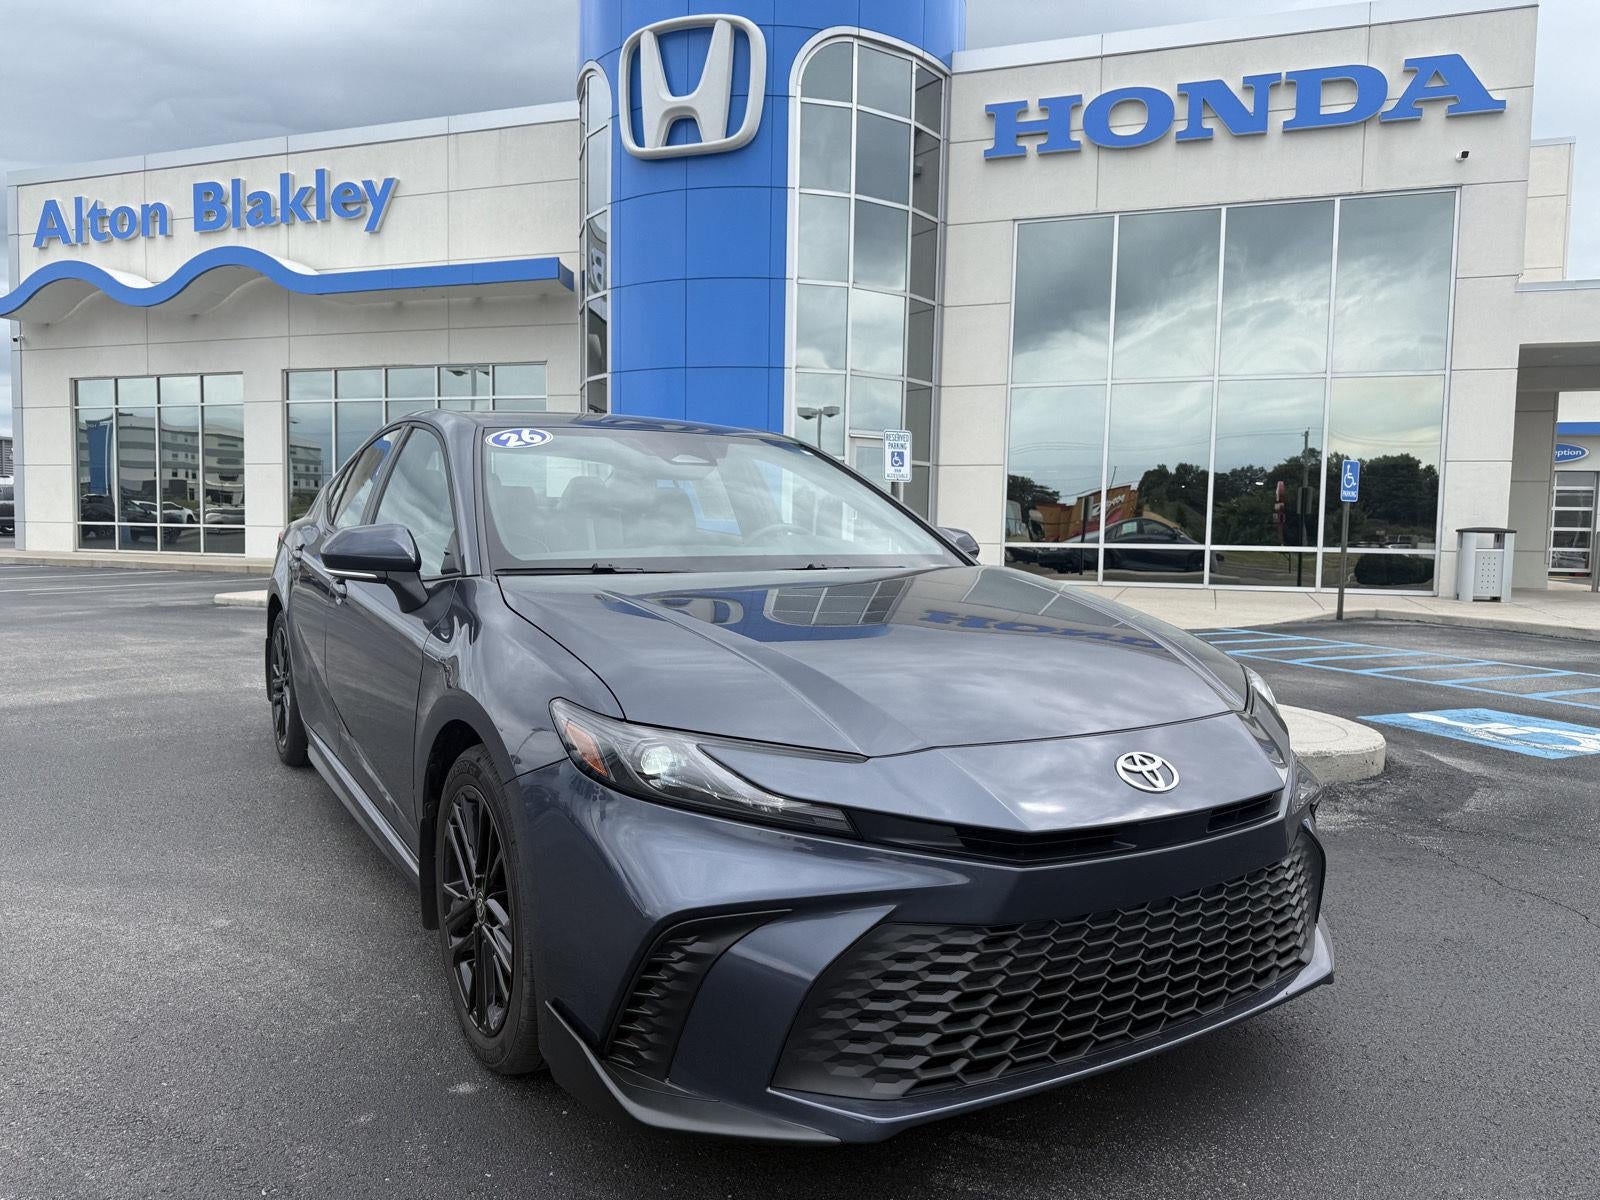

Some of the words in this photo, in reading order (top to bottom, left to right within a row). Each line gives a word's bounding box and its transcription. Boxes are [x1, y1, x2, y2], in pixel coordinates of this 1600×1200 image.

[983, 53, 1507, 160] HONDA
[32, 195, 172, 250] Alton
[192, 168, 400, 234] Blakley
[498, 428, 543, 448] 26
[885, 433, 910, 442] RESERVED
[887, 442, 908, 450] PARKING
